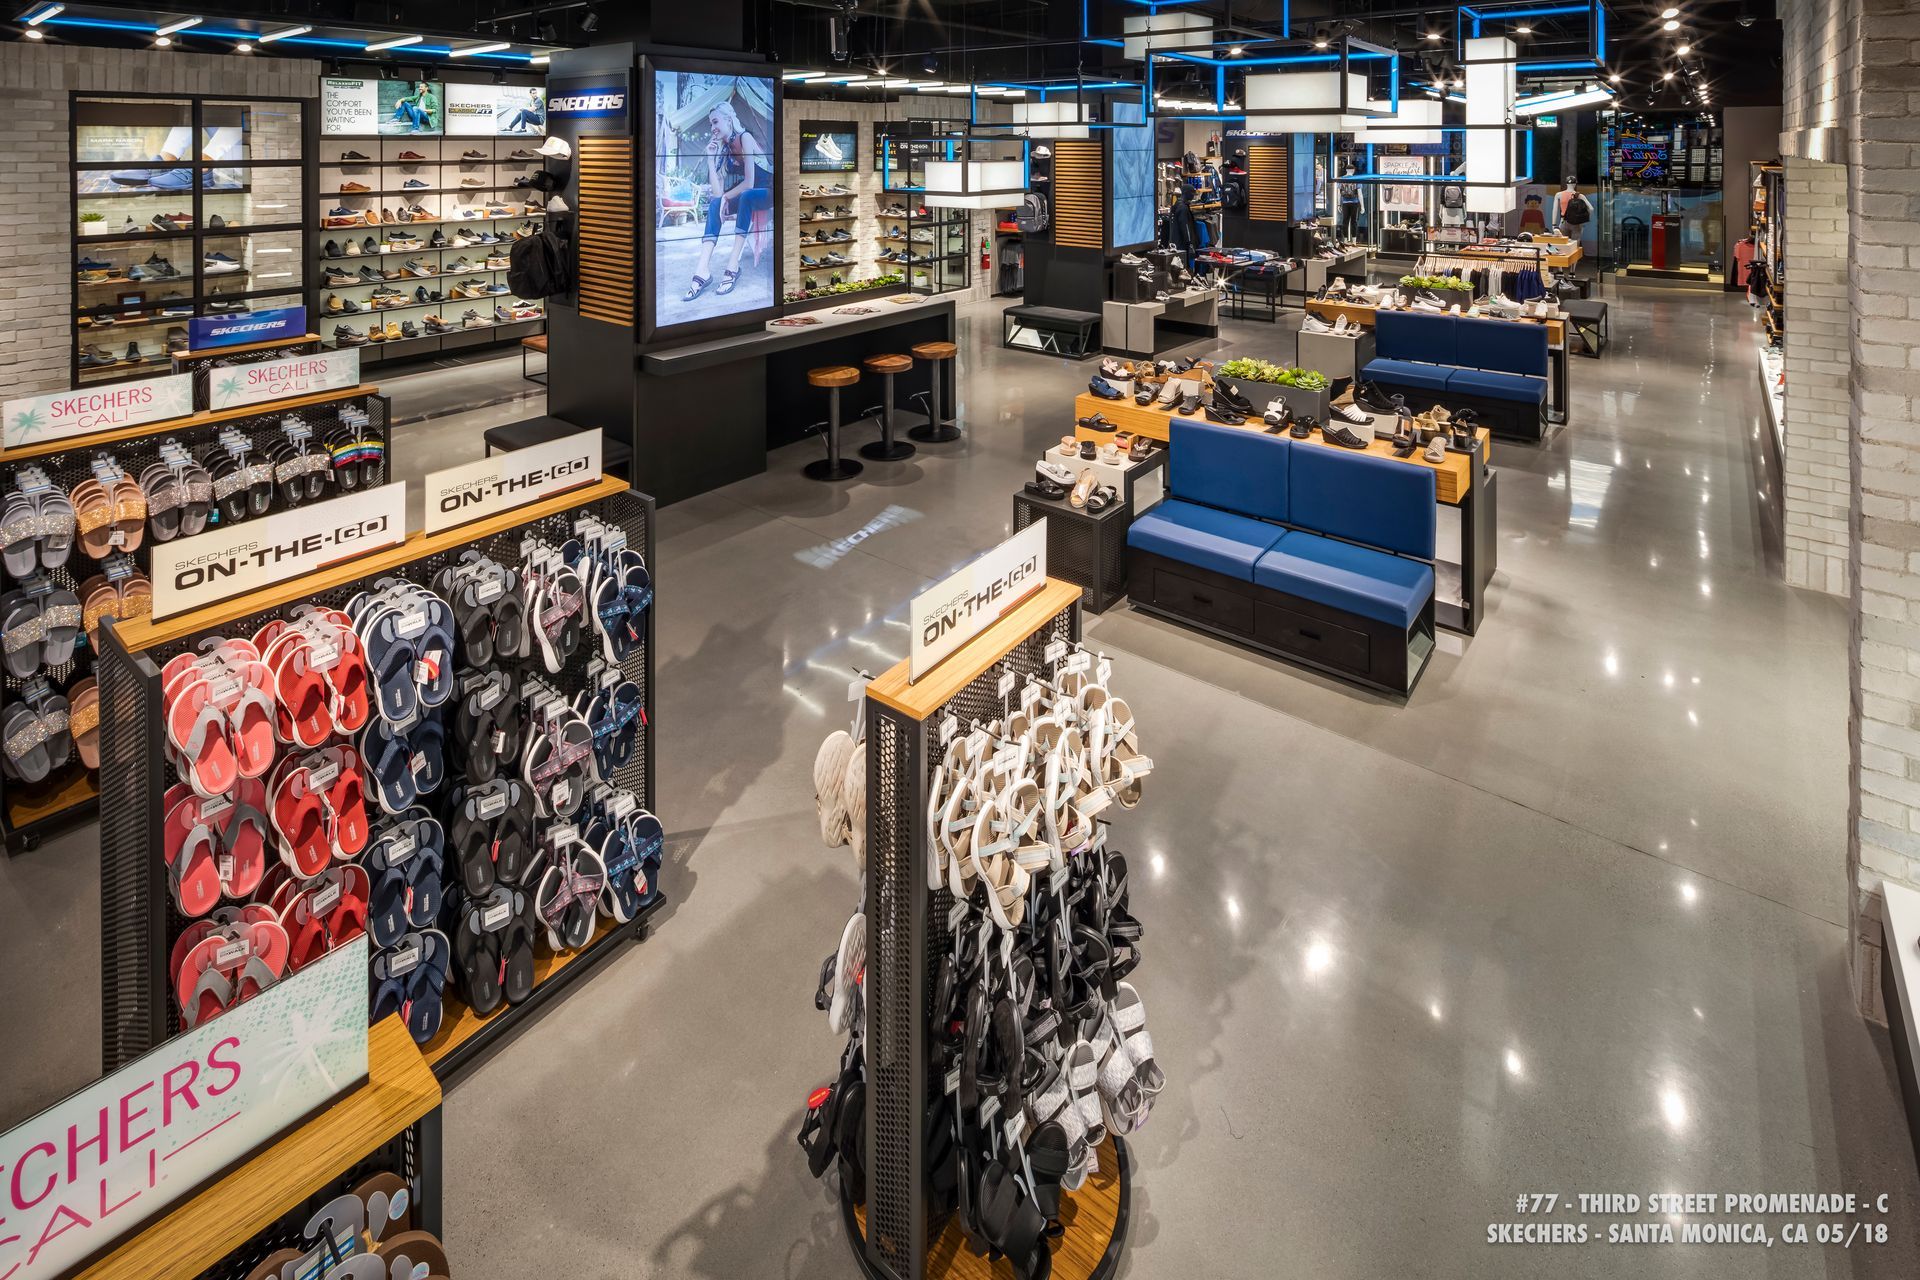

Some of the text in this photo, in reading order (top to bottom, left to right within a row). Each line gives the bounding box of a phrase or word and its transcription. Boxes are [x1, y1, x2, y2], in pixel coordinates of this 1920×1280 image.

[548, 94, 624, 111] SKECHERS
[210, 320, 287, 336] SKECHERS
[248, 359, 328, 385] SKECHERS
[268, 380, 309, 395] CALI
[51, 386, 153, 418] SKECHERS
[78, 409, 129, 429] CALI
[440, 474, 498, 496] SKECHERS
[174, 540, 259, 571] SKECHERS
[923, 590, 969, 626] SKECHERS
[0, 1036, 241, 1211] CHERS
